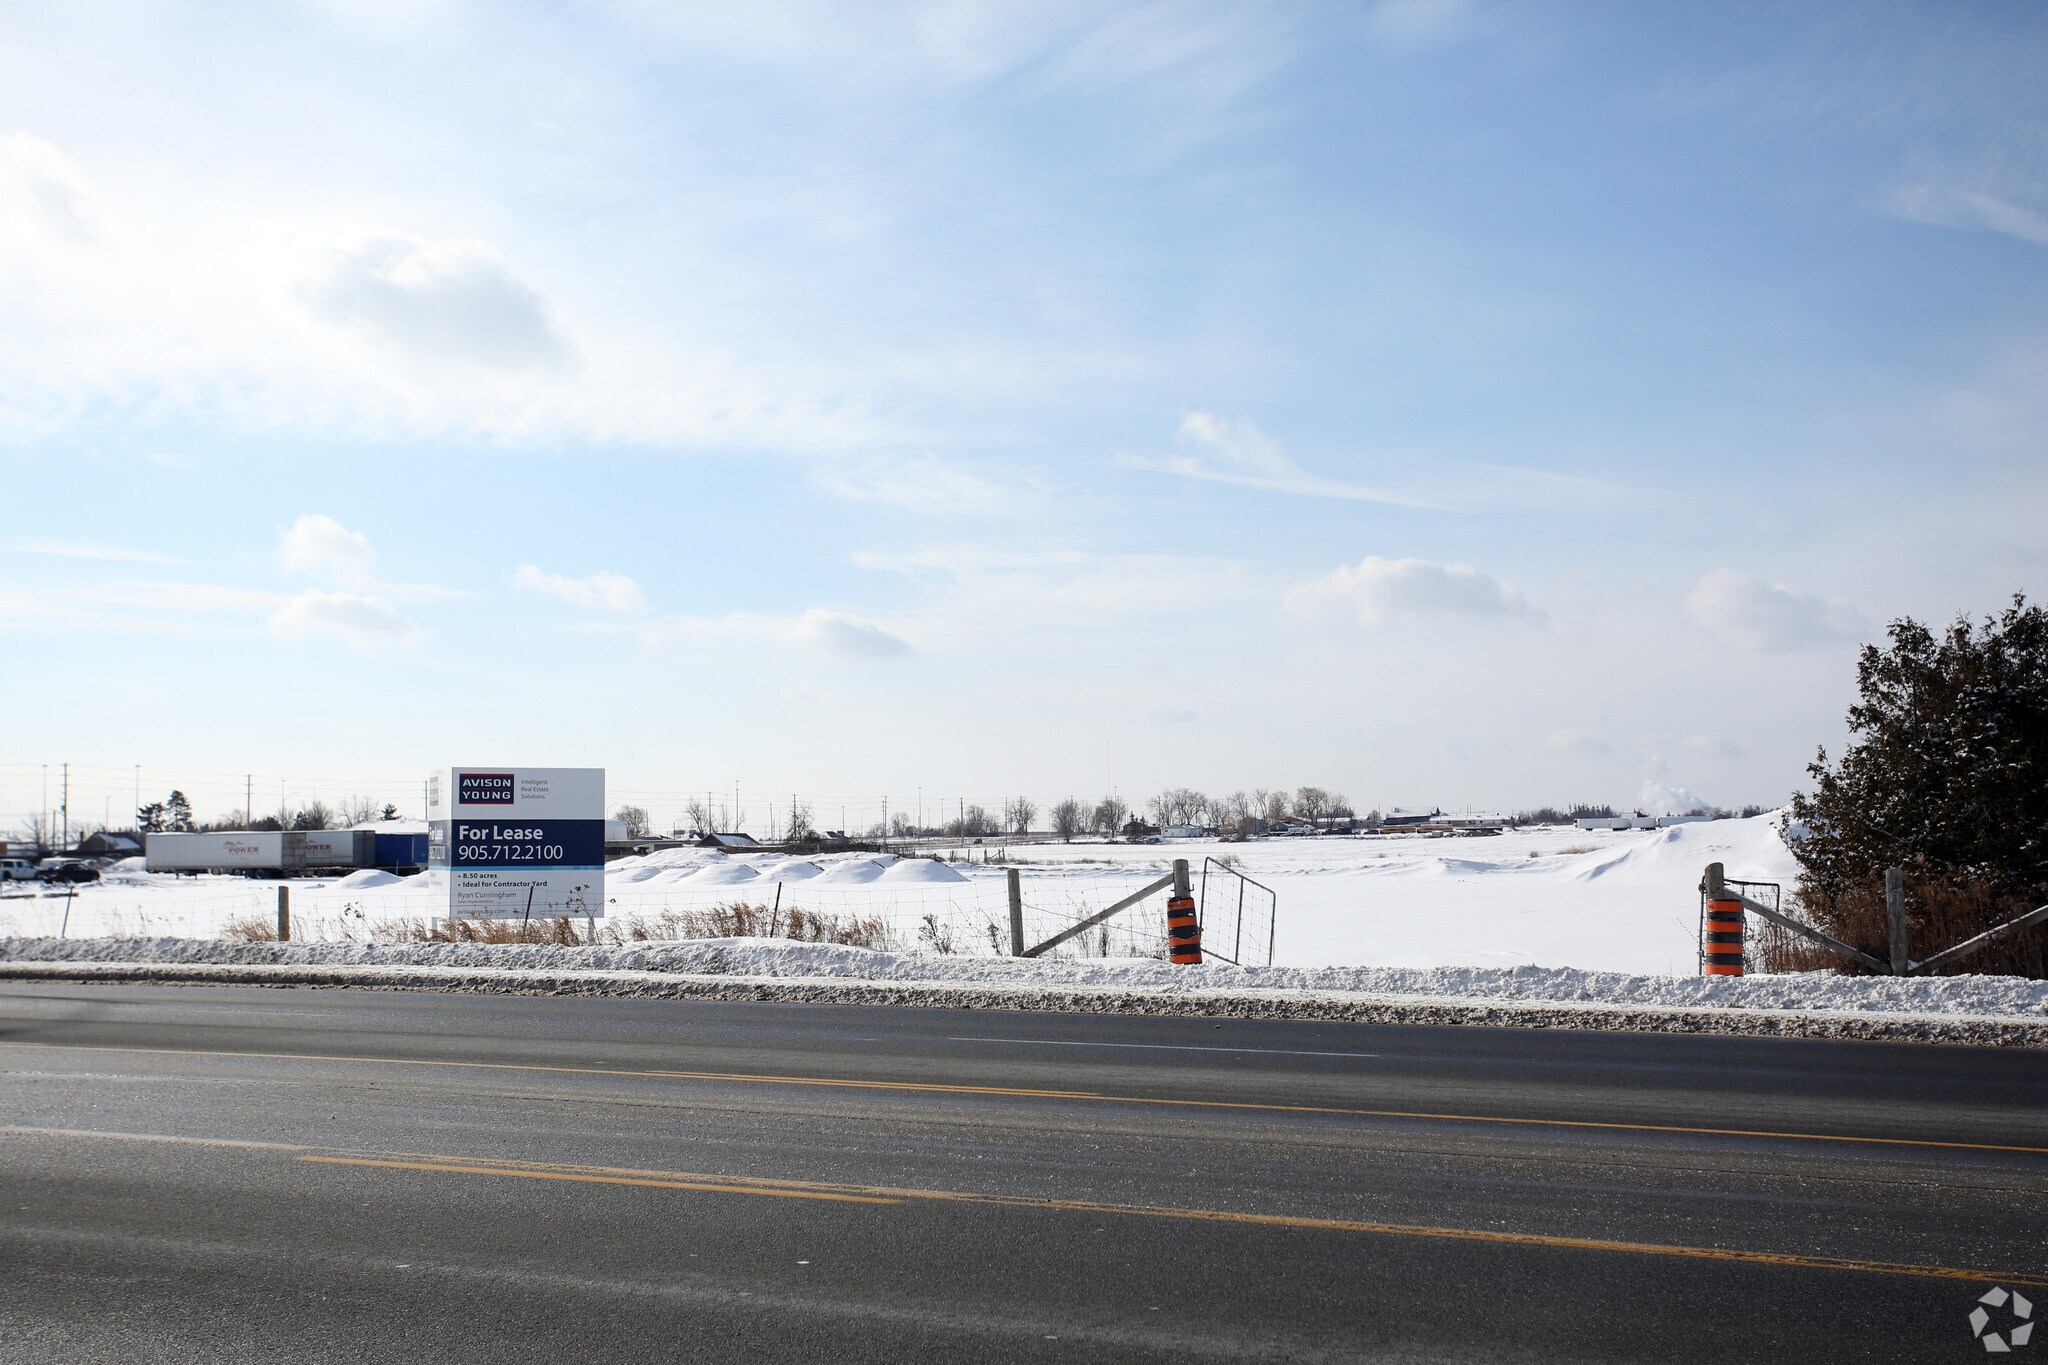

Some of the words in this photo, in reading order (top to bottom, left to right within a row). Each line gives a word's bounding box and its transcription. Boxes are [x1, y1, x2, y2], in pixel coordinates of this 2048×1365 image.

[462, 779, 511, 787] AVISON
[462, 791, 511, 799] YOUNG
[459, 826, 489, 840] For
[493, 826, 543, 840] Lease
[458, 845, 564, 860] 905.712.2100
[475, 891, 517, 899] Cunningham
